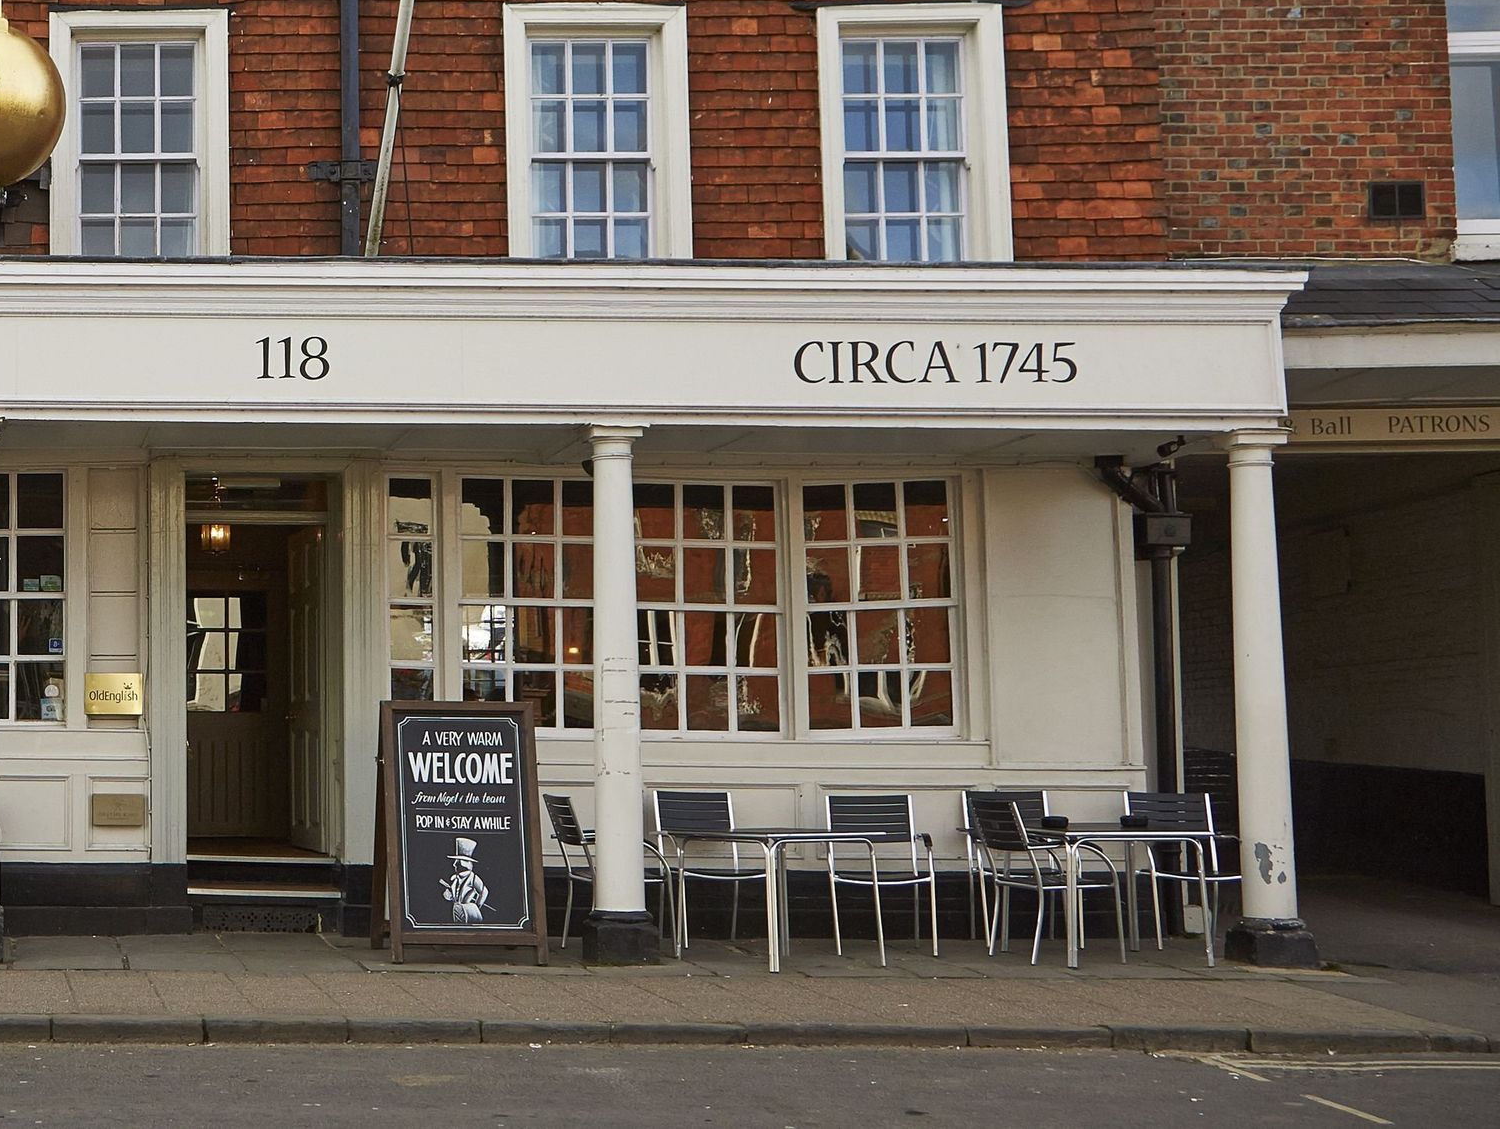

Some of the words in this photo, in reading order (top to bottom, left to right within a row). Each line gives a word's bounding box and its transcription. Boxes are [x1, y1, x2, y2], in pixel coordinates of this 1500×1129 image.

[255, 336, 331, 381] 118
[793, 340, 960, 384] CIRCA
[975, 341, 1078, 384] 1745
[1311, 416, 1352, 435] Ball
[1387, 414, 1491, 434] PATRONS
[89, 690, 138, 704] OldEnglish
[422, 730, 431, 746] A
[435, 731, 464, 747] VERY
[467, 731, 503, 746] WARM
[407, 751, 514, 784] WELCOME
[411, 791, 437, 805] from
[436, 791, 460, 806] Nigel
[465, 792, 480, 804] the
[482, 792, 506, 804] team
[415, 814, 434, 828] POP
[434, 815, 445, 829] IN
[451, 816, 473, 829] STAY
